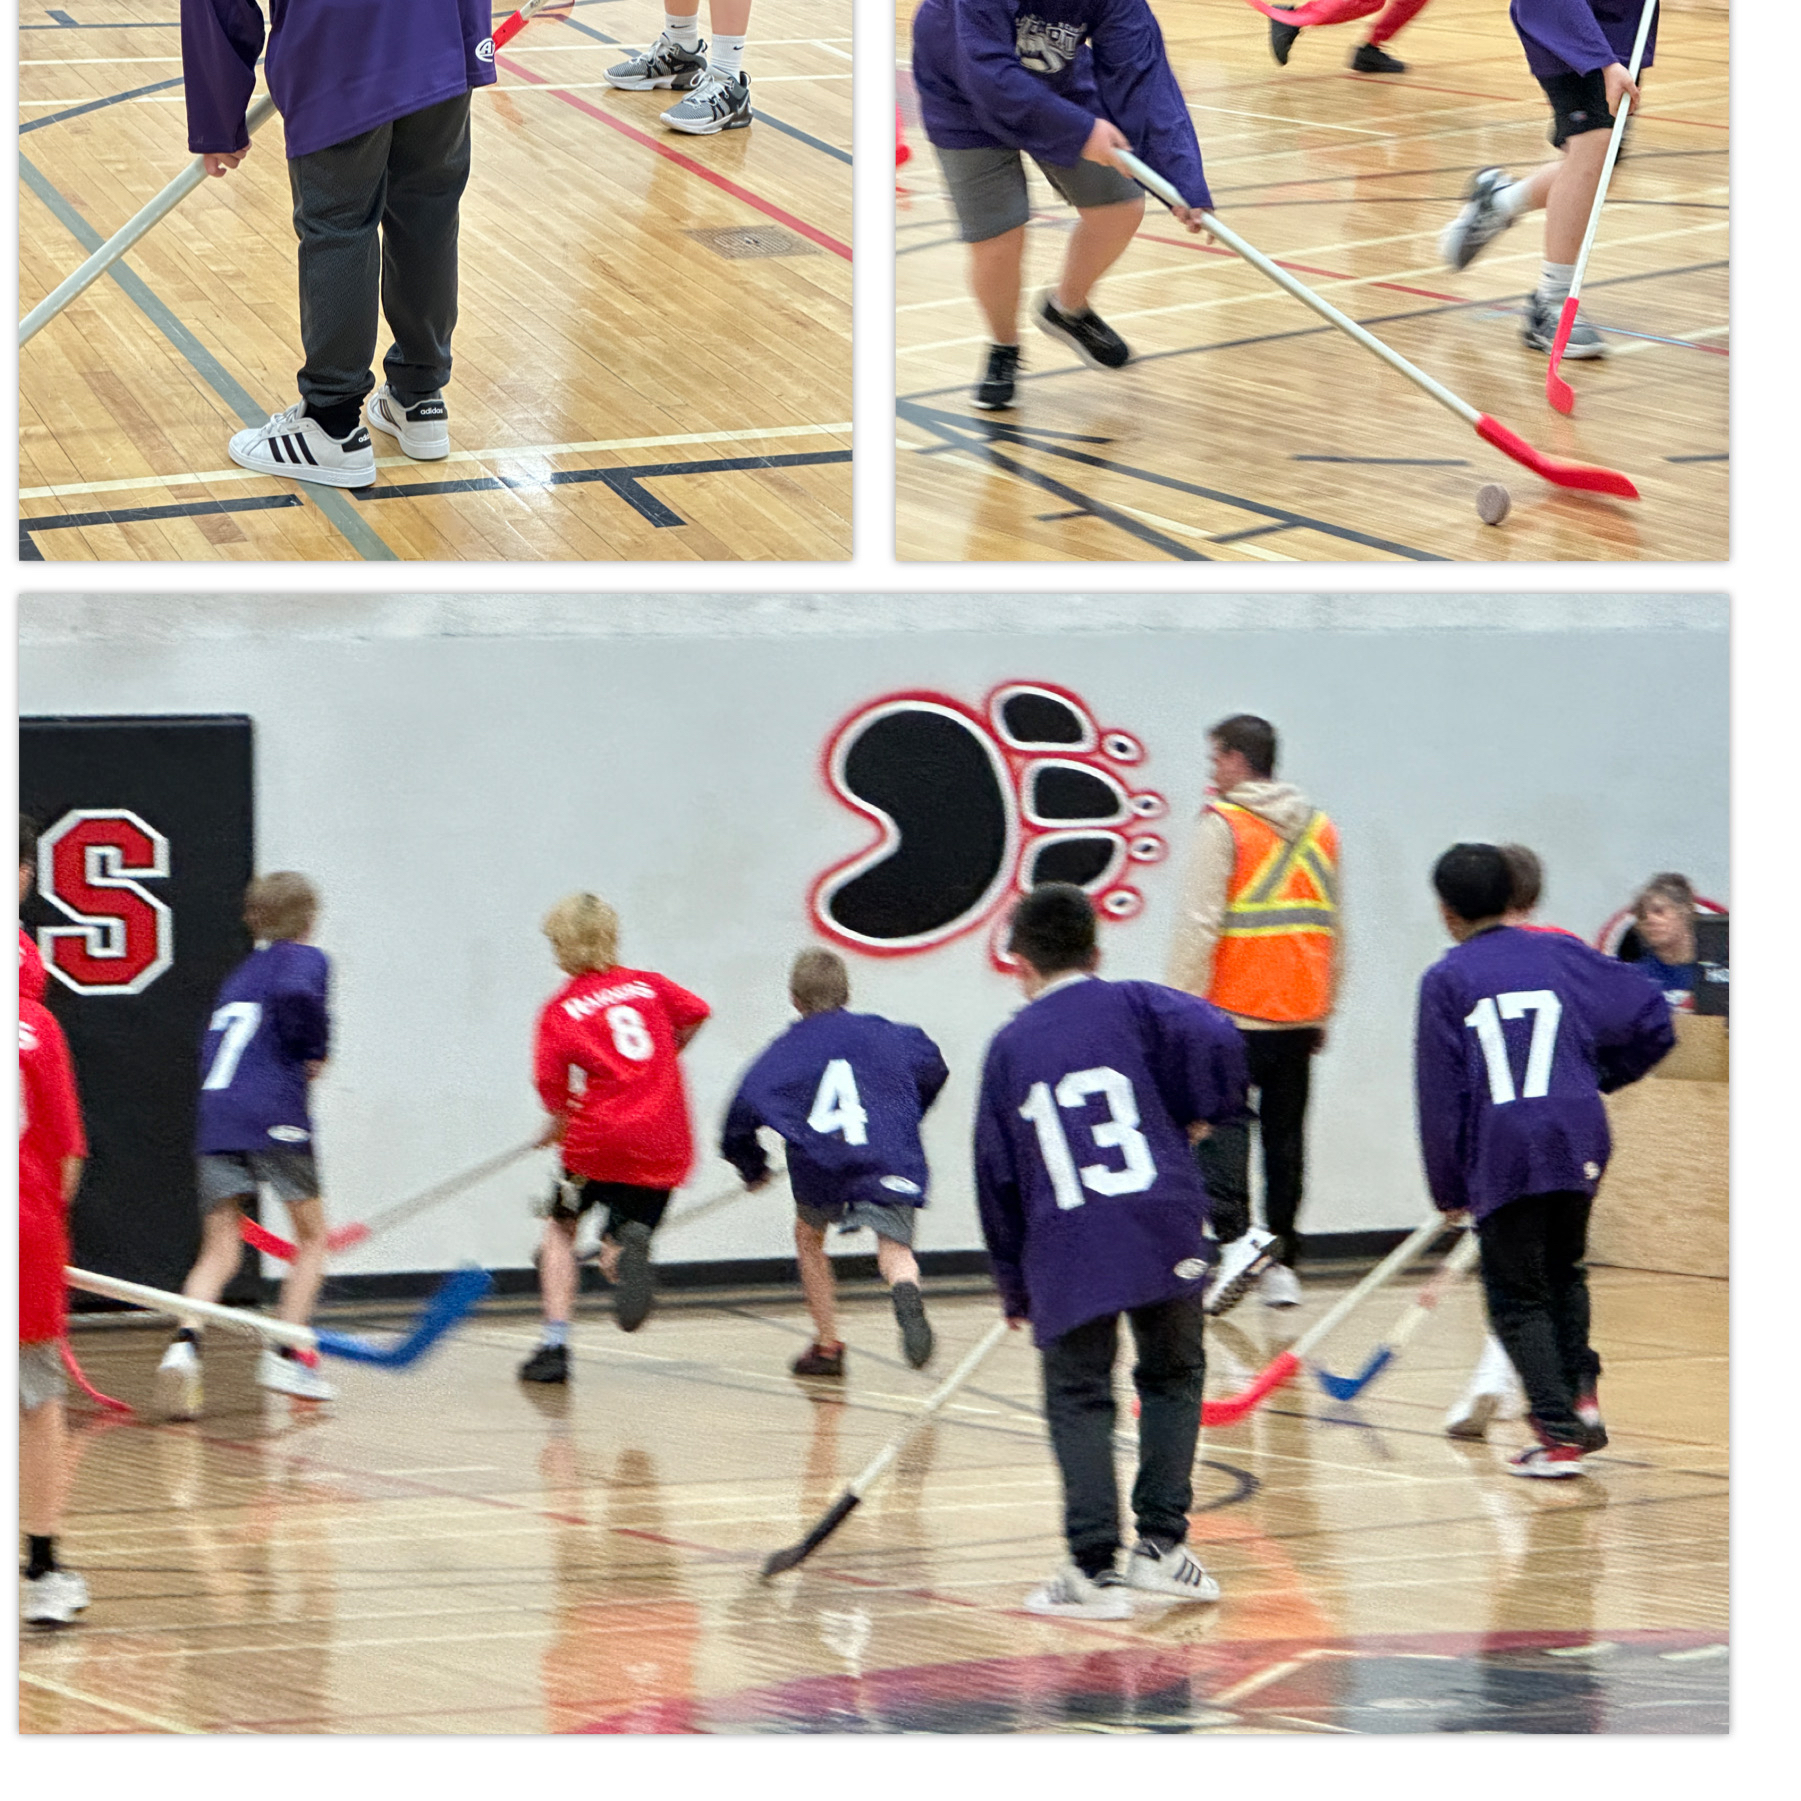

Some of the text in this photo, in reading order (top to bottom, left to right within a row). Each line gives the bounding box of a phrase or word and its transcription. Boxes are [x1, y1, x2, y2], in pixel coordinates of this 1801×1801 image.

[37, 809, 174, 996] S
[201, 1002, 263, 1090] 7
[606, 1004, 655, 1061] 8
[1463, 990, 1563, 1105] 17
[807, 1058, 869, 1147] 4
[1018, 1066, 1159, 1211] 13
